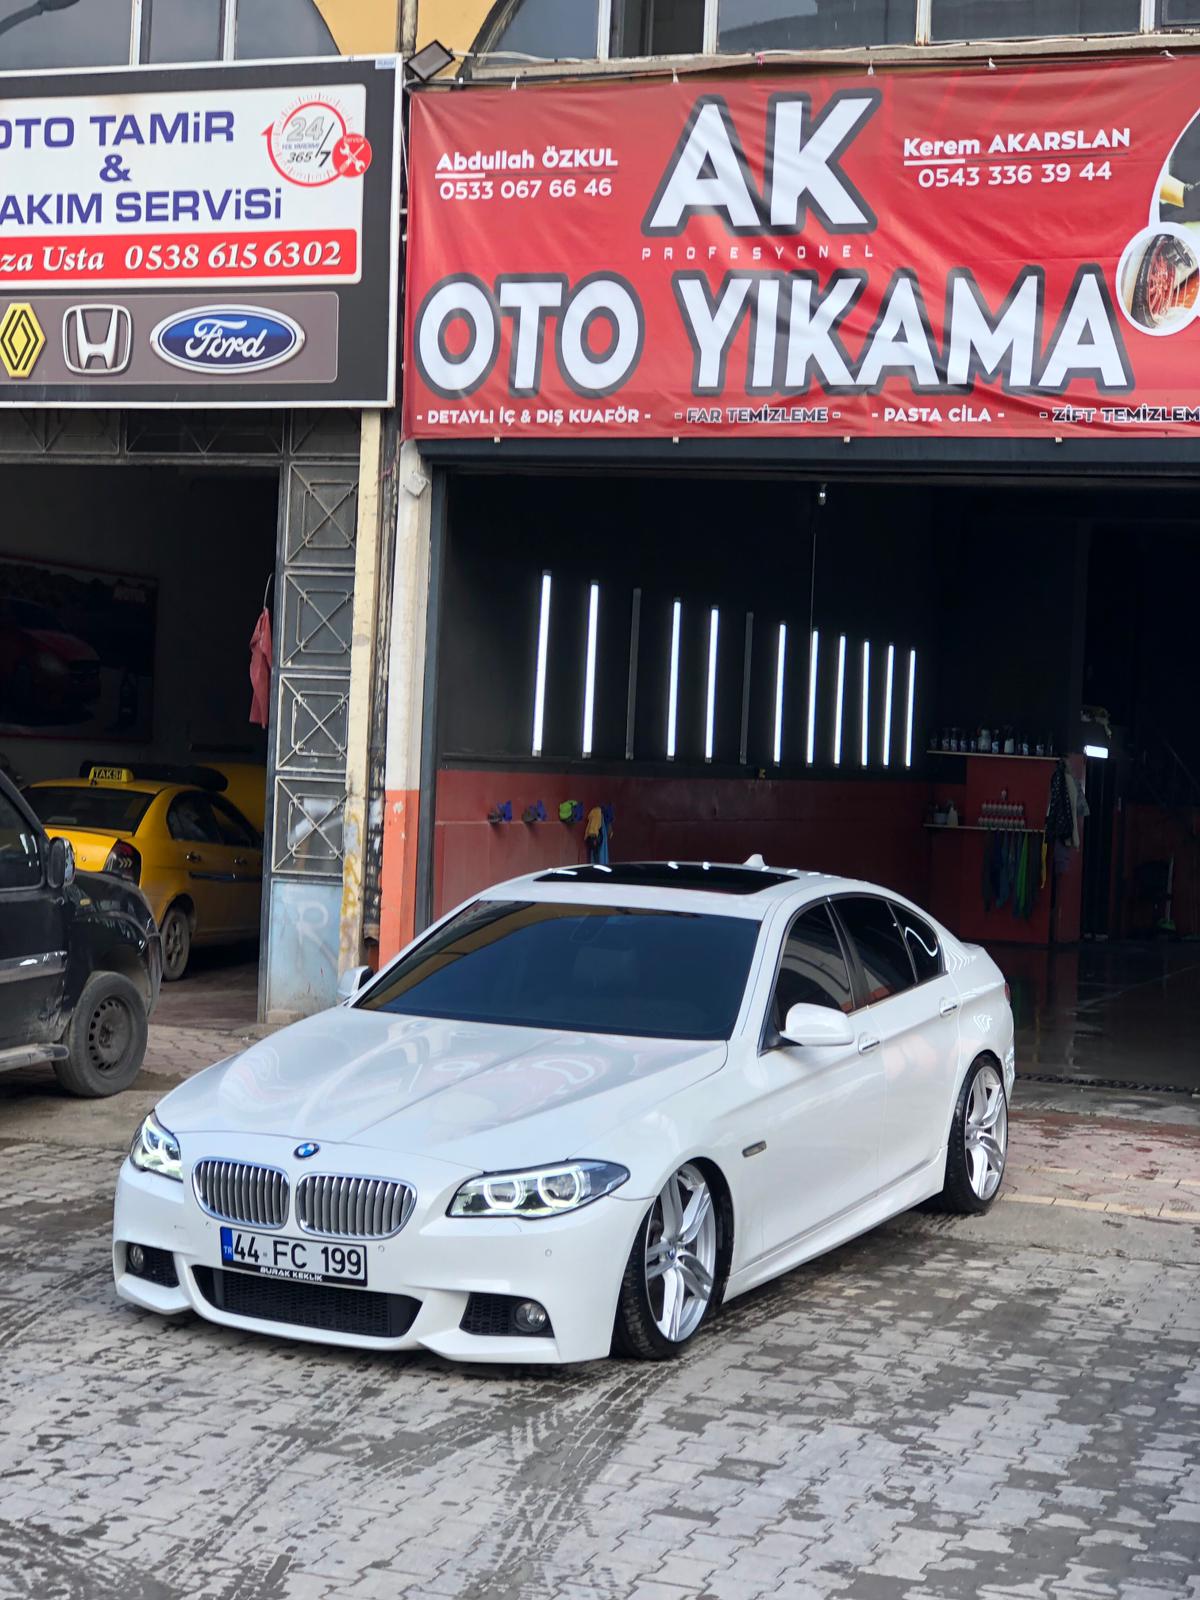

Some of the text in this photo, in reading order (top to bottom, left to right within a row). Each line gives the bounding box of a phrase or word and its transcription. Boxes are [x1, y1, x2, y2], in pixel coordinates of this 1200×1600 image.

[903, 127, 1130, 157] Kerem AKARSLAN
[99, 154, 132, 183] &
[436, 145, 618, 171] Abdullah ÖZKUL
[645, 94, 877, 231] AK
[918, 160, 1113, 189] 0543 336 39 44
[439, 177, 612, 201] 0533 067 66 46
[42, 245, 106, 272] Usta
[124, 243, 200, 271] 0538
[207, 241, 258, 270] 615
[263, 240, 342, 268] 6302
[641, 244, 874, 261] PROFESYONEL
[185, 318, 267, 359] Ford
[415, 270, 1130, 394] OTO YIKAMA
[427, 409, 494, 424] DETAYLI
[499, 405, 516, 427] İÇ
[520, 409, 532, 424] &
[536, 409, 564, 427] DIŞ
[568, 406, 639, 424] KUAFÖR
[686, 407, 722, 424] FAR
[725, 403, 829, 424] TEMİZLEME
[884, 407, 943, 423] PASTA
[948, 403, 992, 423] CİLA
[1051, 404, 1097, 423] ZİFT
[223, 1232, 362, 1276] TR 44 FC 199
[260, 1266, 291, 1279] BURAK
